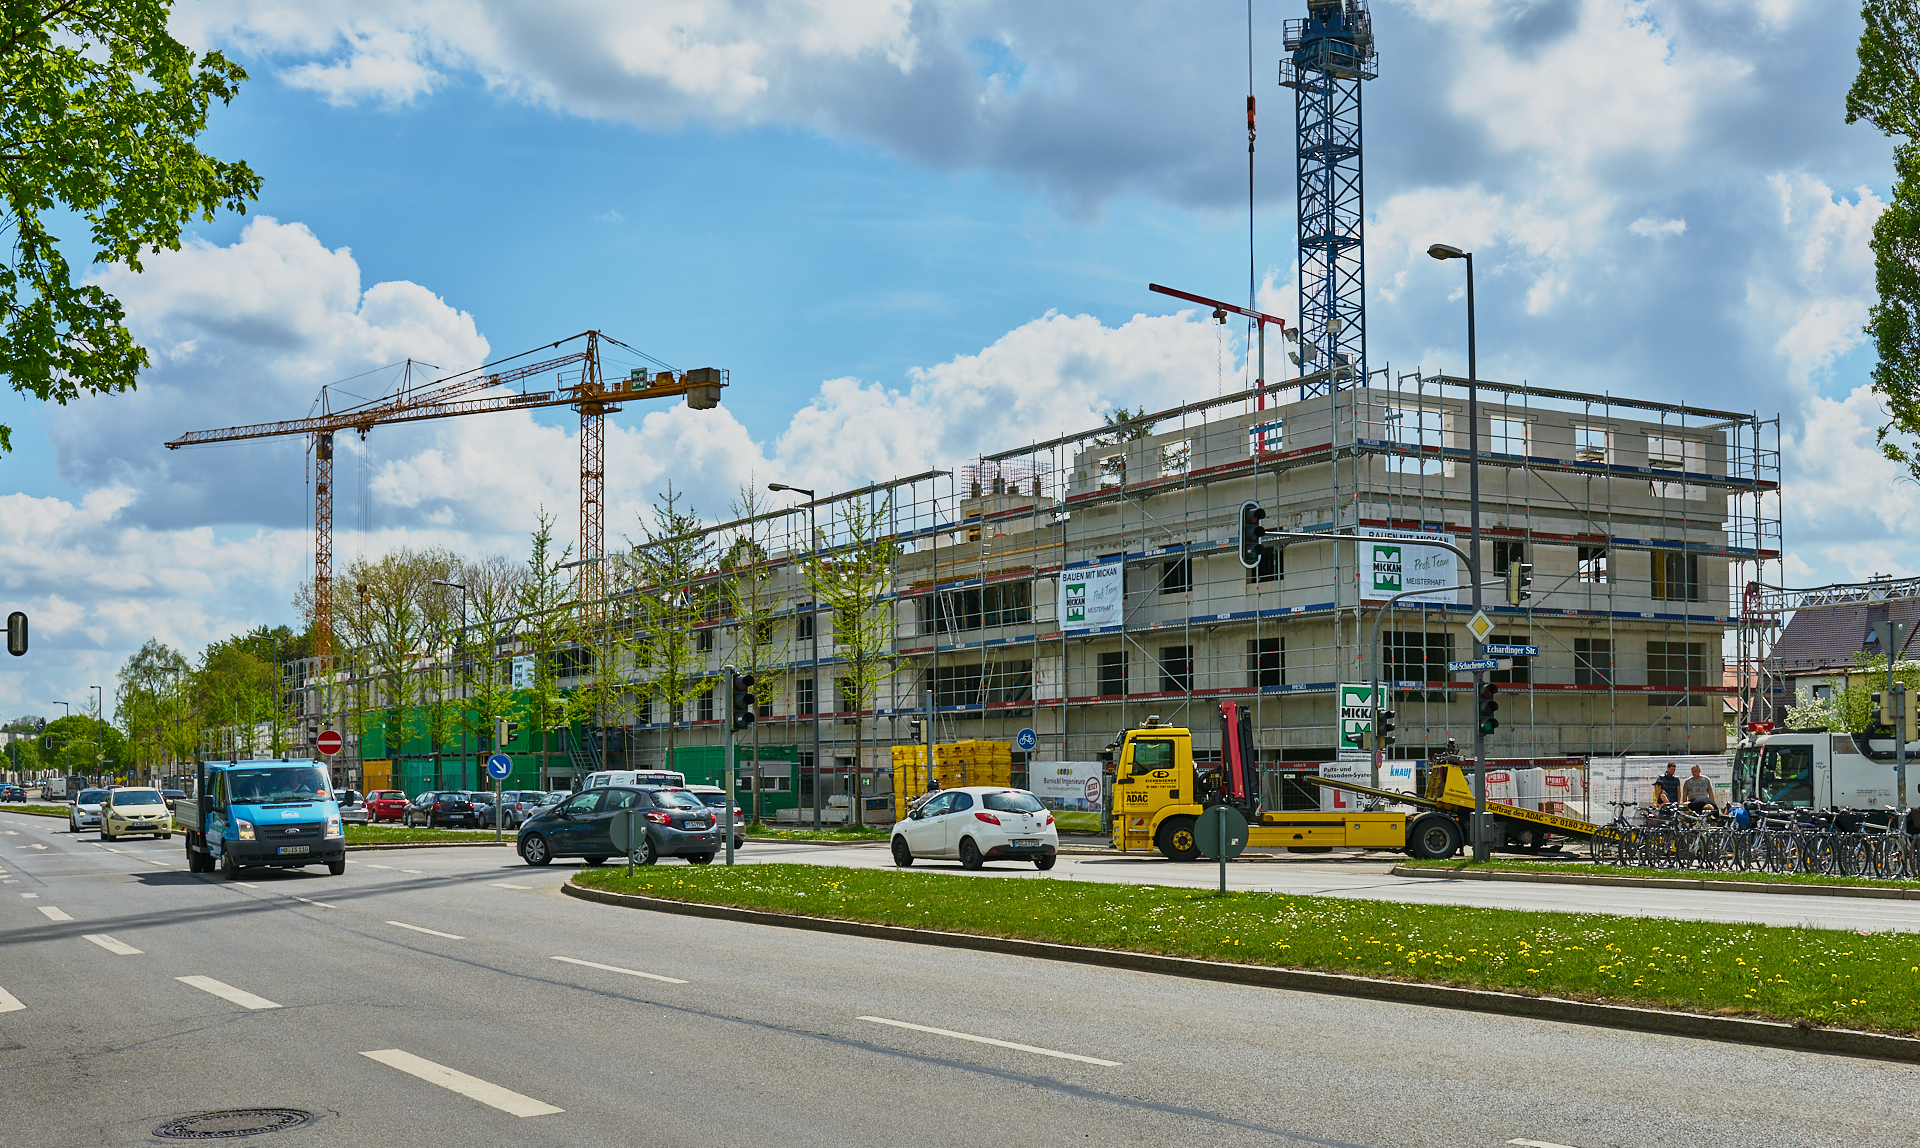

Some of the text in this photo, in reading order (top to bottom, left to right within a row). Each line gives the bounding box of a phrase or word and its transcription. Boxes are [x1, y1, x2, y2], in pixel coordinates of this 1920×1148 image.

[1414, 554, 1449, 570] Profi Team
[1373, 563, 1401, 572] MICKAN
[1063, 567, 1117, 581] BAUEN MIT MICKAN
[1406, 578, 1446, 586] MEISTERHAFT
[1106, 583, 1117, 595] Team
[1067, 598, 1085, 606] MICKAN
[1088, 605, 1114, 613] MEISTERHAFT
[1487, 646, 1524, 655] Echardinger
[1450, 660, 1495, 670] Bad-Schachener-Str.
[1062, 777, 1085, 786] Ingenieure
[1126, 794, 1148, 802] ADAC
[1488, 803, 1511, 815] Auftrag
[1513, 809, 1524, 817] des
[1526, 812, 1543, 821] ADAC
[1560, 819, 1577, 828] 0180
